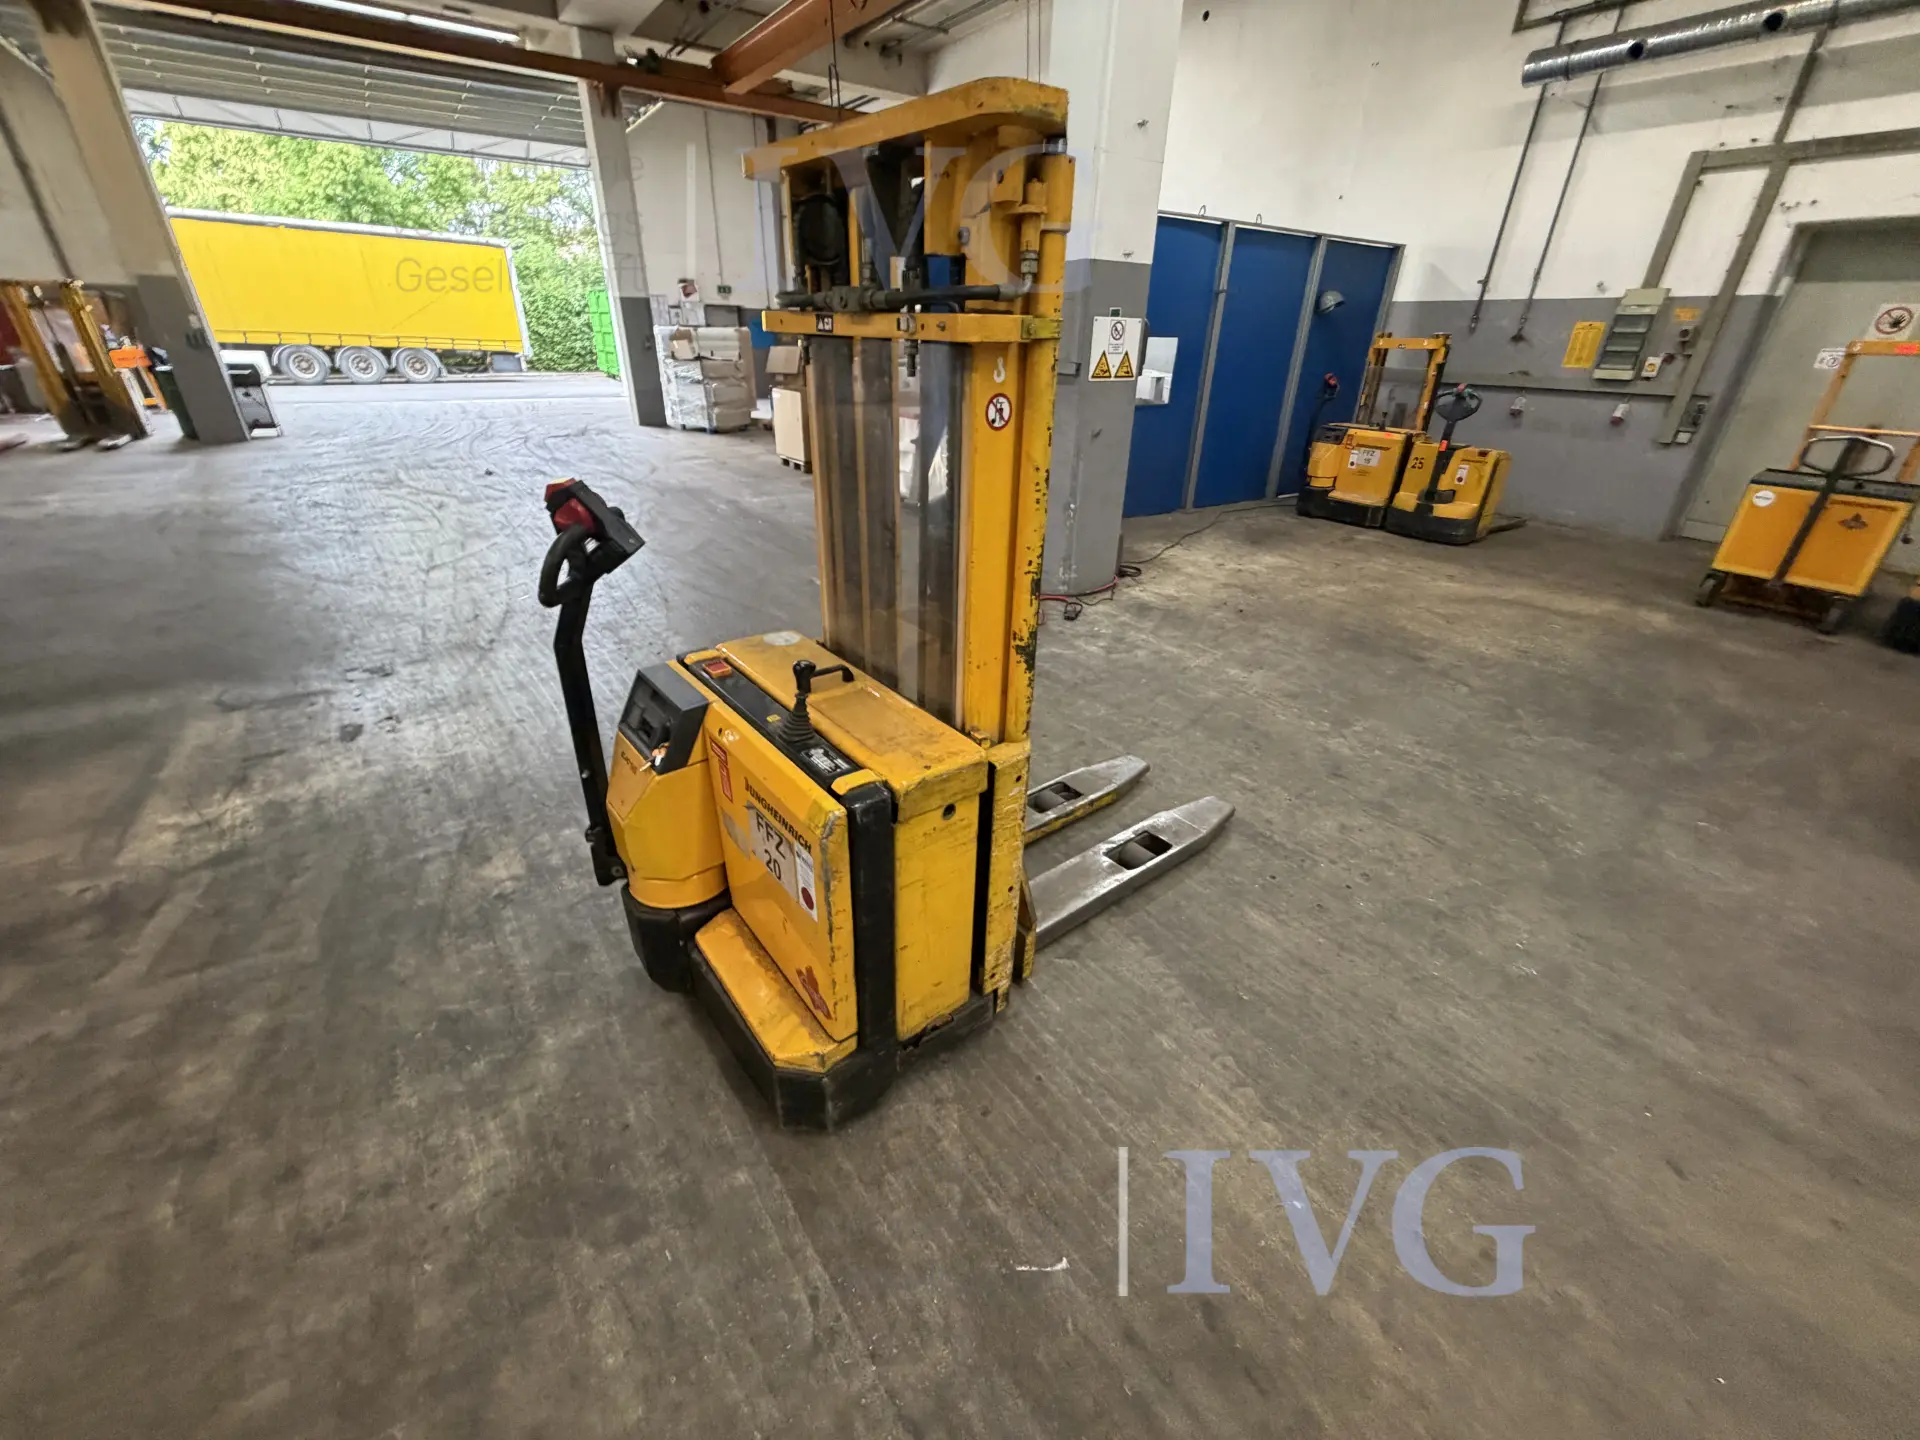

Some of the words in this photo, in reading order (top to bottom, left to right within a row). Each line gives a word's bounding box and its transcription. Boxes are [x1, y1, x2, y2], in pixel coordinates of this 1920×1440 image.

[1411, 457, 1425, 469] 25
[744, 777, 812, 854] JUNGHEINRICH
[756, 811, 786, 860] FFZ
[764, 849, 782, 882] 20
